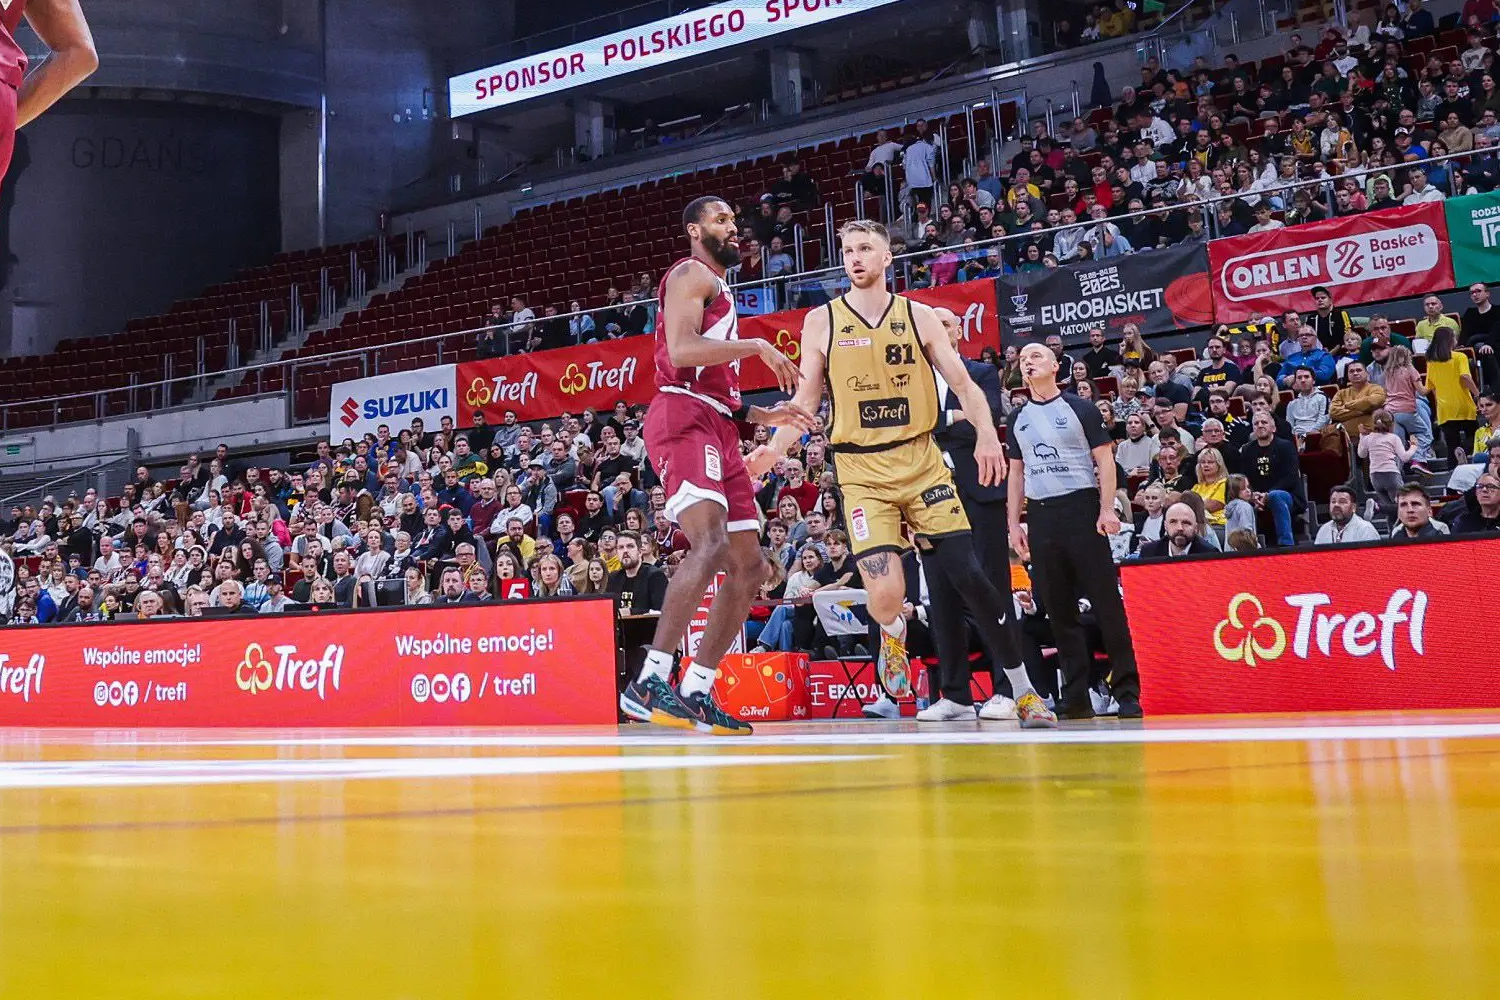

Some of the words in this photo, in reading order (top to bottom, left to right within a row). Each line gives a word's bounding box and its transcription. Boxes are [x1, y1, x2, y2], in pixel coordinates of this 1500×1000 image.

[474, 52, 585, 100] SPONSOR
[603, 9, 745, 67] POLSKIEGO
[1232, 254, 1321, 290] ORLEN
[1369, 231, 1424, 253] Basket
[1372, 253, 1406, 272] Liga
[1080, 273, 1120, 296] 2025
[1041, 288, 1163, 325] EUROBASKET
[1059, 319, 1106, 336] KATOWICE
[885, 343, 916, 365] 81
[586, 357, 637, 391] Trefl
[492, 371, 537, 406] Trefl
[363, 387, 448, 420] SUZUKI
[878, 404, 907, 421] Trefl
[508, 583, 526, 599] 5
[1284, 588, 1428, 671] Trefl
[395, 631, 472, 657] Wspólne
[477, 628, 553, 654] emocje!
[83, 647, 140, 668] Wspólne
[145, 644, 201, 667] emocje!
[274, 644, 345, 700] Trefl
[493, 672, 536, 696] trefl
[155, 682, 186, 701] trefl
[828, 684, 868, 699] ERGO
